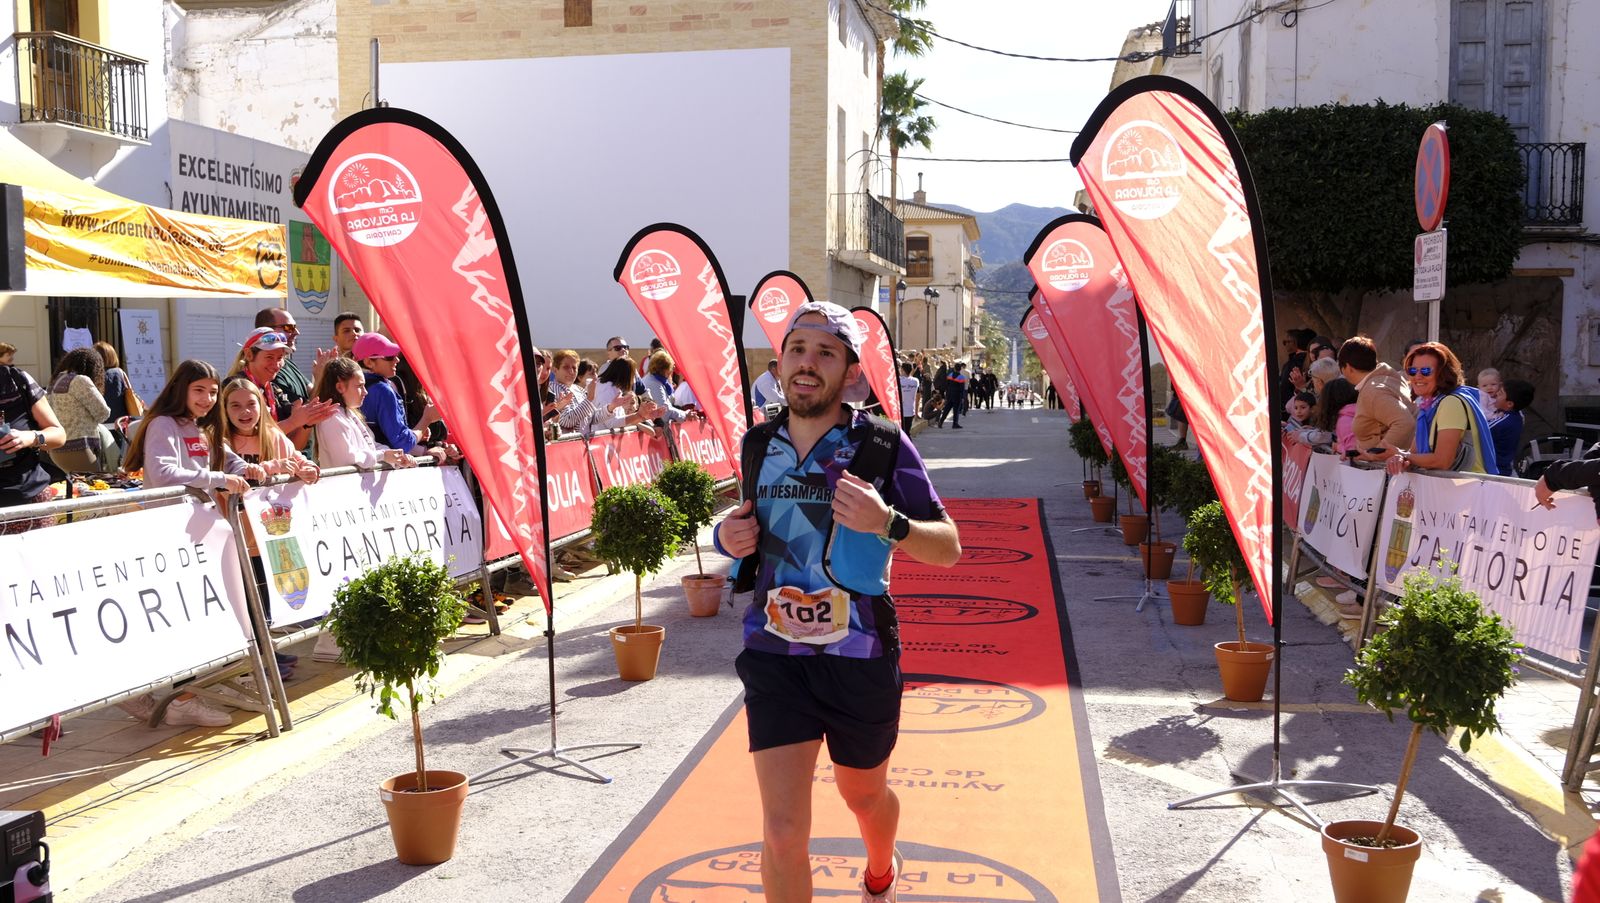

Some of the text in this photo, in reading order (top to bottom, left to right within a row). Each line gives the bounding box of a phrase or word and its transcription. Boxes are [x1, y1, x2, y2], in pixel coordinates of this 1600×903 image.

[178, 153, 282, 195] EXCELENTÍSIMO
[181, 191, 280, 224] AYUNTAMIENTO
[691, 437, 726, 465] VEOLIA
[625, 452, 664, 486] VEOLIA
[770, 485, 836, 502] DESAMPAR
[311, 492, 463, 531] AYUNTAMIENTO DE
[316, 514, 472, 576] CANTORIA
[1420, 510, 1580, 560] AYUNTAMIENTO DE
[9, 543, 207, 607] TAMIENTO DE
[5, 574, 226, 671] NTORIA
[780, 601, 832, 623] 102
[947, 768, 985, 777] de
[946, 872, 1003, 888] LA
